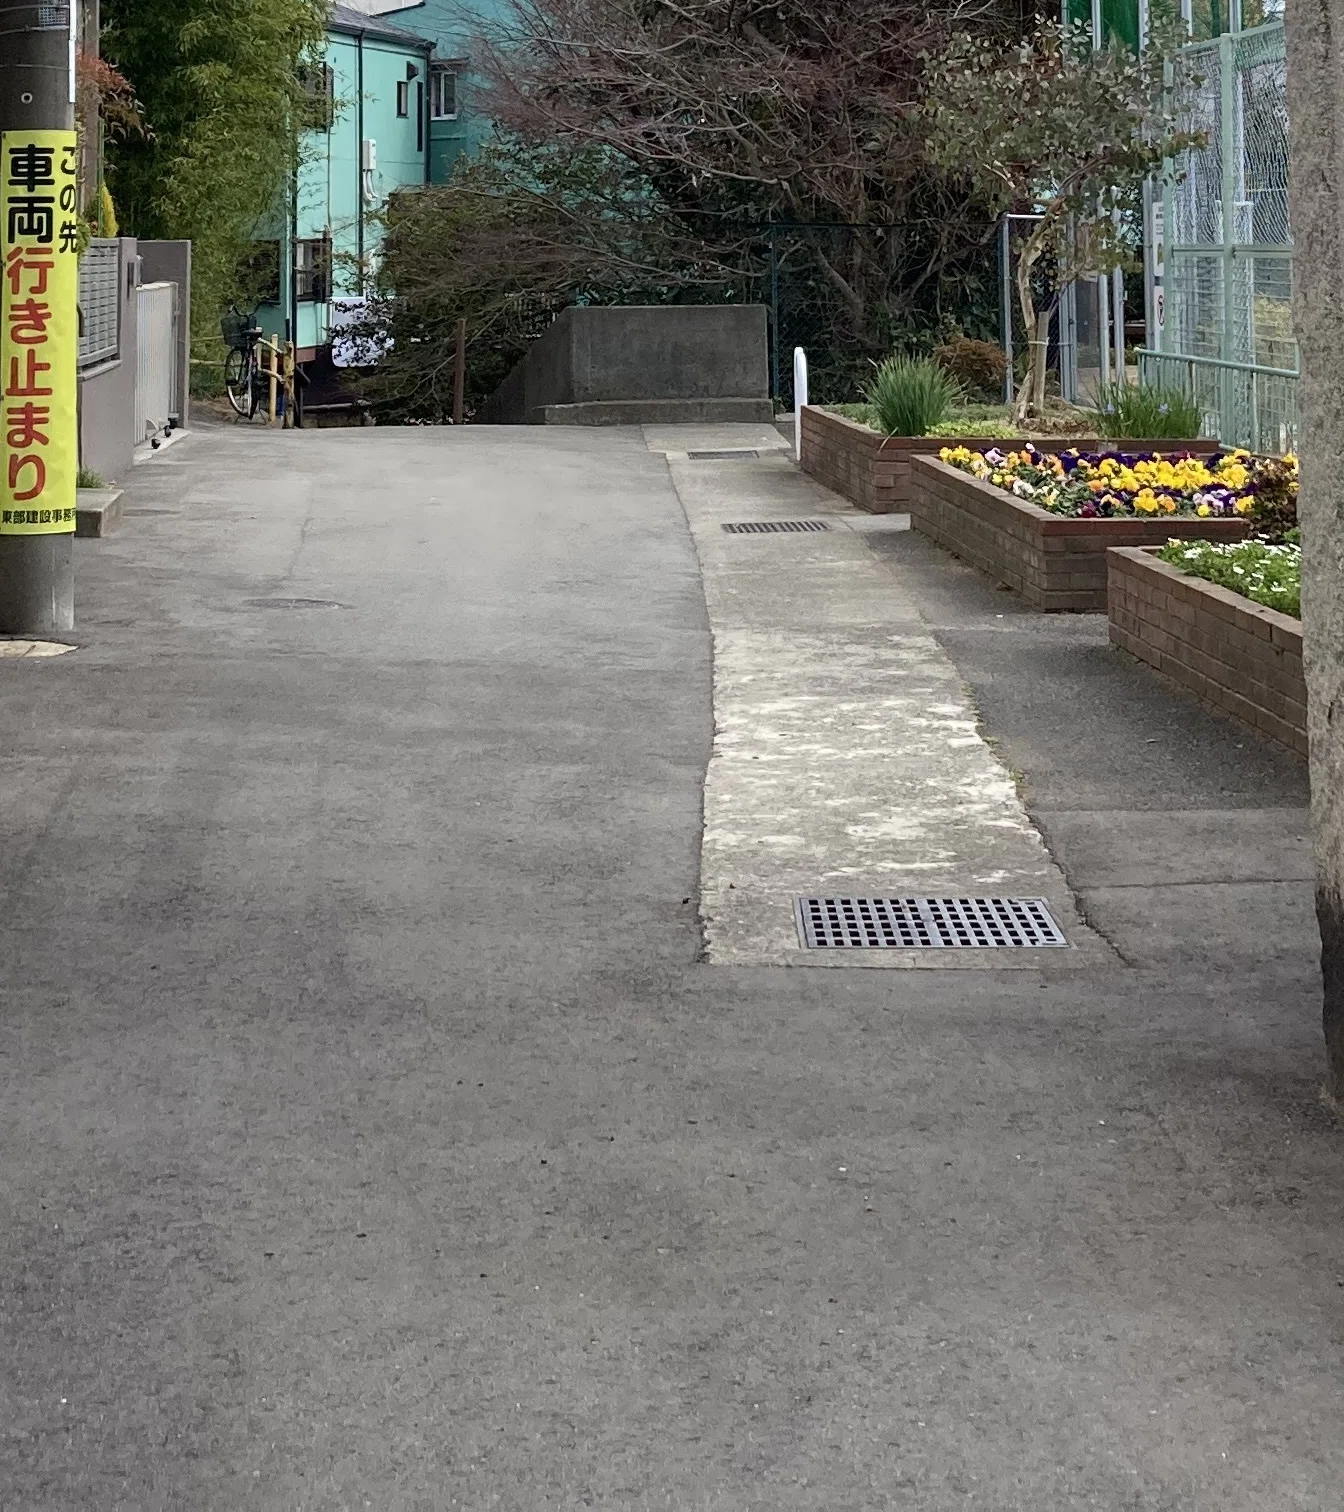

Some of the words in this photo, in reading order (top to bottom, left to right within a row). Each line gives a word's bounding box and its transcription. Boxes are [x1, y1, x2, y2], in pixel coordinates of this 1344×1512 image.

[59, 146, 77, 253] この先
[6, 143, 55, 500] 車両行き止まり
